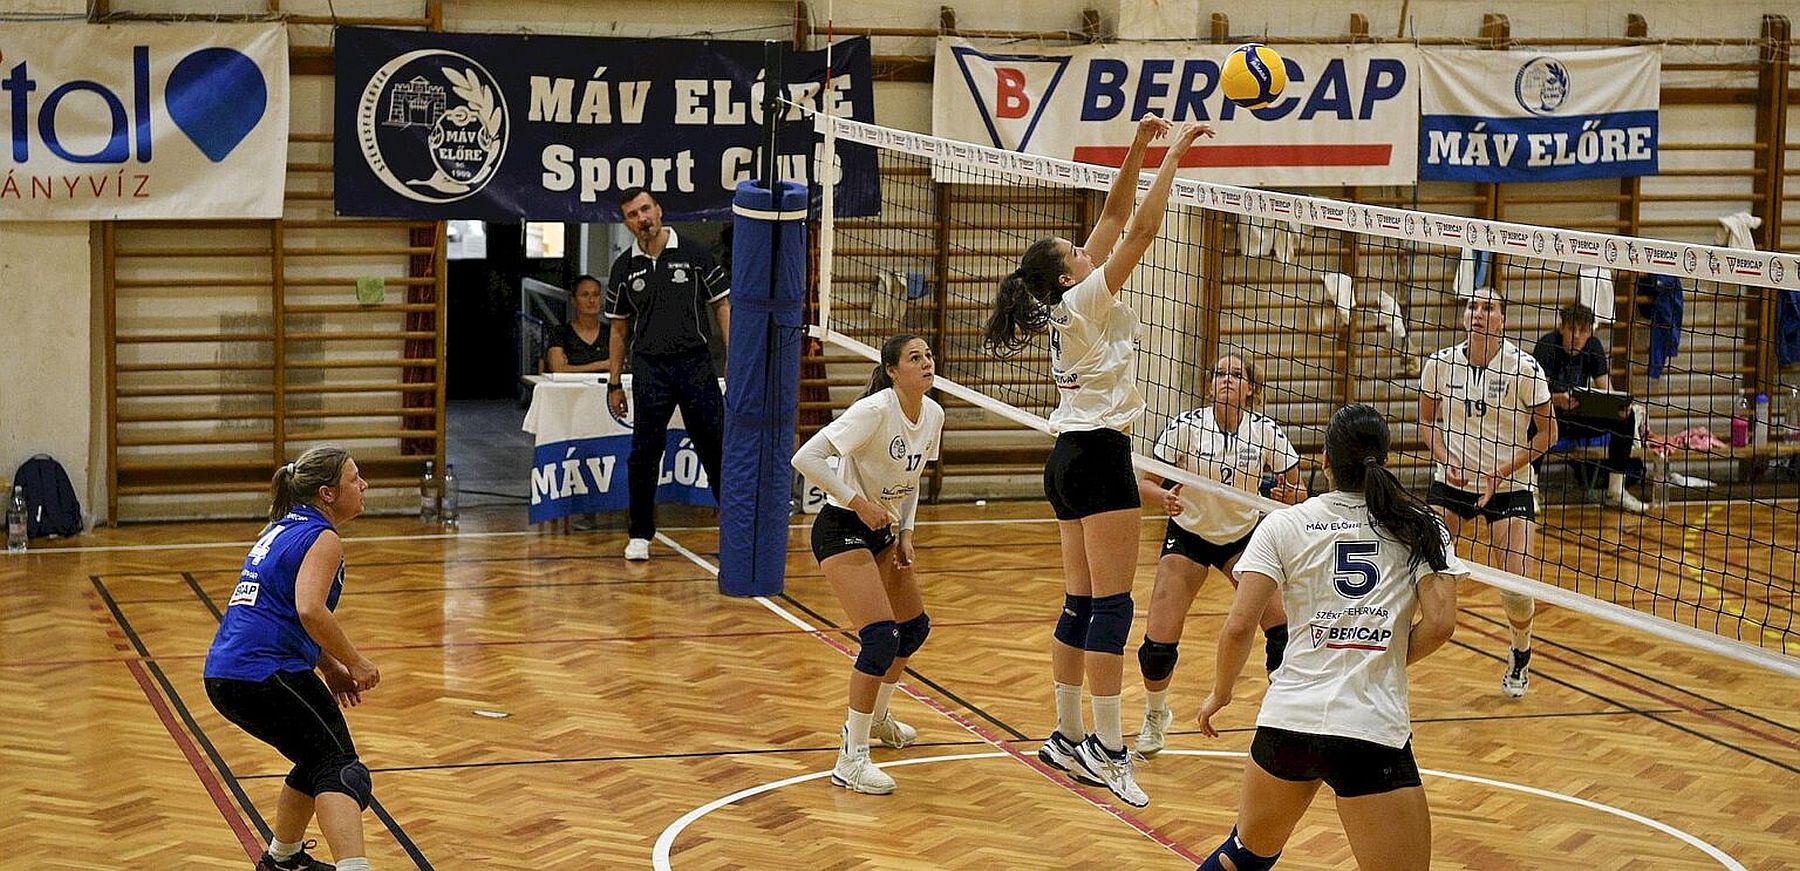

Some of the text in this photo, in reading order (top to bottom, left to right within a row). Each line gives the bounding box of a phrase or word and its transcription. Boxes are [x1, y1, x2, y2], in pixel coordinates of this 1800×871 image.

[0, 46, 152, 163] tal
[527, 66, 652, 124] MÁV
[995, 67, 1031, 119] B
[439, 145, 483, 162] ELŐRE
[446, 128, 476, 144] MÁV
[1427, 120, 1652, 167] MÁV ELŐRE
[541, 144, 696, 203] Sport
[1465, 400, 1487, 418] 19
[531, 447, 616, 506] MÁV
[905, 454, 922, 472] 17
[1221, 467, 1233, 486] 2
[248, 524, 286, 567] 4
[1333, 539, 1381, 600] 5
